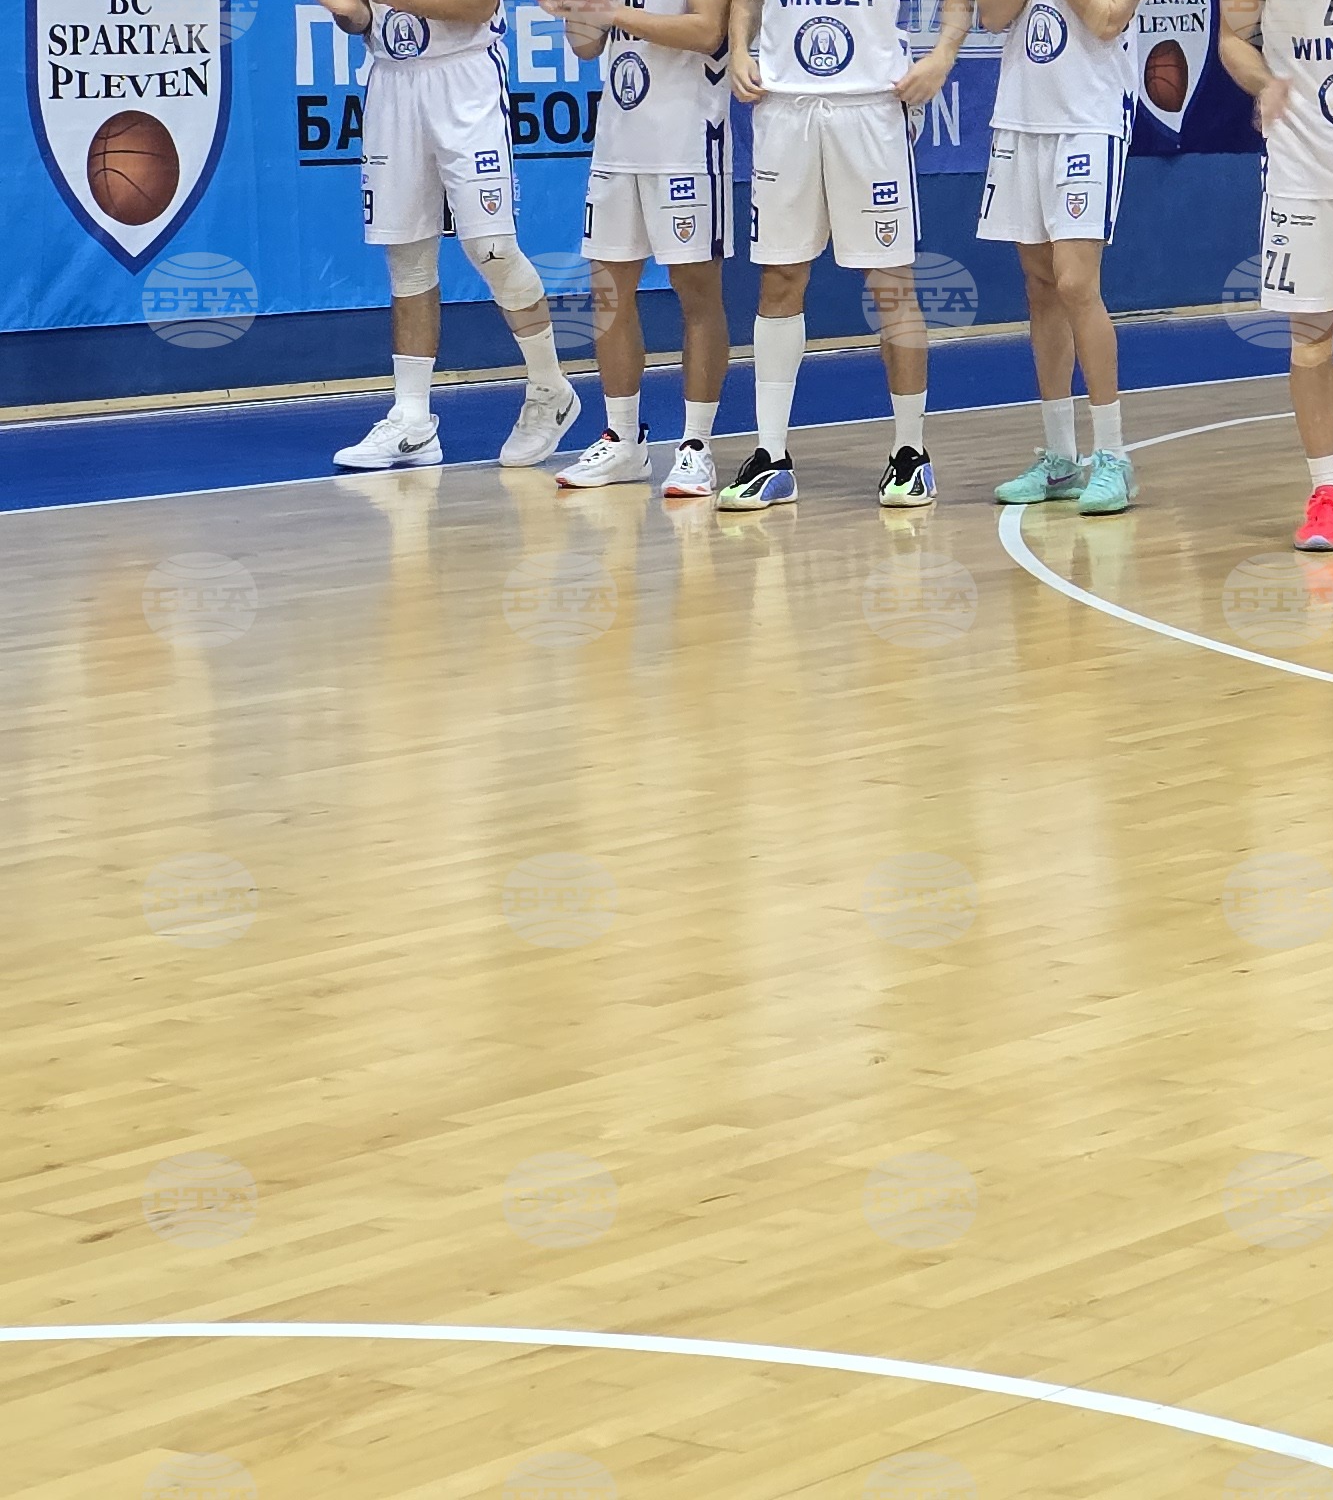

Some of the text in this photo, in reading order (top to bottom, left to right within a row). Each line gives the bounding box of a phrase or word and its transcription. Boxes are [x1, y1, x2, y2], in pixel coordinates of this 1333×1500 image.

[48, 23, 211, 56] SPARTAK
[1138, 11, 1206, 35] LEVEN
[48, 58, 211, 100] PLEVEN
